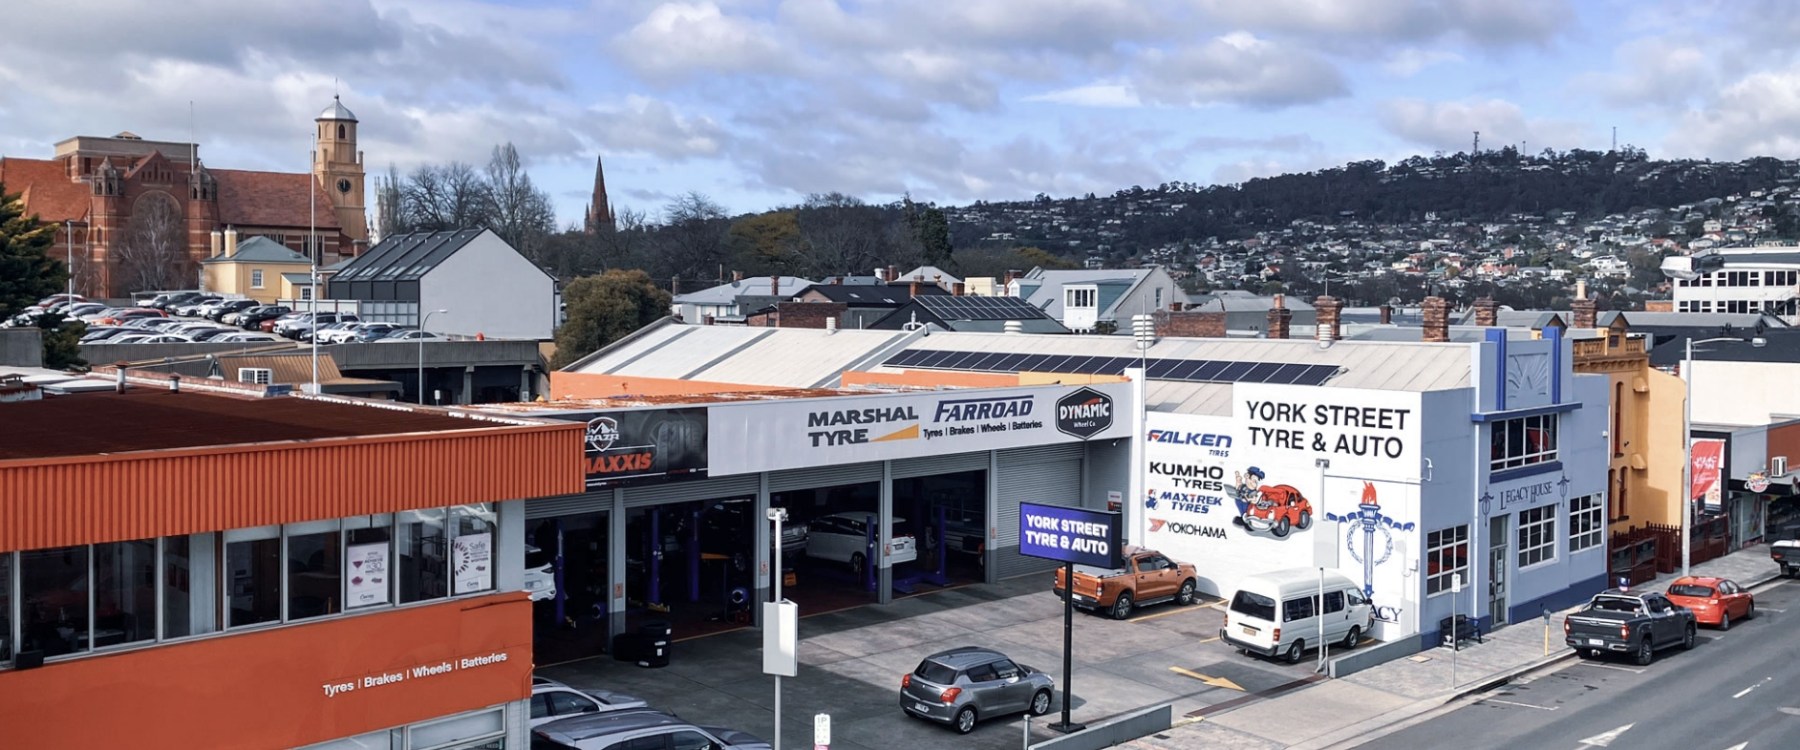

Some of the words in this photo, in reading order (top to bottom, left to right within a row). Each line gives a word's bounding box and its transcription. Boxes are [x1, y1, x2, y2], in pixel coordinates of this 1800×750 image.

[808, 406, 919, 427] MARSHAL
[933, 396, 1034, 422] FARROAD
[1246, 400, 1307, 423] YORK
[1314, 404, 1411, 430] STREET
[808, 428, 869, 447] TYRE
[923, 428, 943, 440] Tyres
[950, 425, 975, 436] Brakes
[981, 422, 1007, 433] Wheels
[1012, 419, 1043, 431] Batteries
[1248, 426, 1304, 450] TYRE
[1311, 432, 1327, 452] &
[1333, 434, 1403, 459] AUTO
[1208, 449, 1229, 458] TIRES
[1149, 461, 1224, 480] KUMHO
[1171, 477, 1223, 492] TYRES
[1160, 491, 1223, 506] MAXTREK
[1500, 486, 1529, 510] LEGACY
[1530, 481, 1552, 503] HOUSE
[1172, 501, 1209, 514] TYRES
[1025, 514, 1060, 532] YORK
[1060, 519, 1109, 538] STREET
[1166, 521, 1228, 540] YOKOHAMA
[1025, 530, 1058, 549] TYRE
[1059, 535, 1071, 550] &
[1071, 537, 1109, 556] AUTO
[323, 682, 354, 697] Tyres
[364, 671, 404, 687] Brakes
[412, 662, 453, 678] Wheels
[461, 652, 508, 669] Batteries
